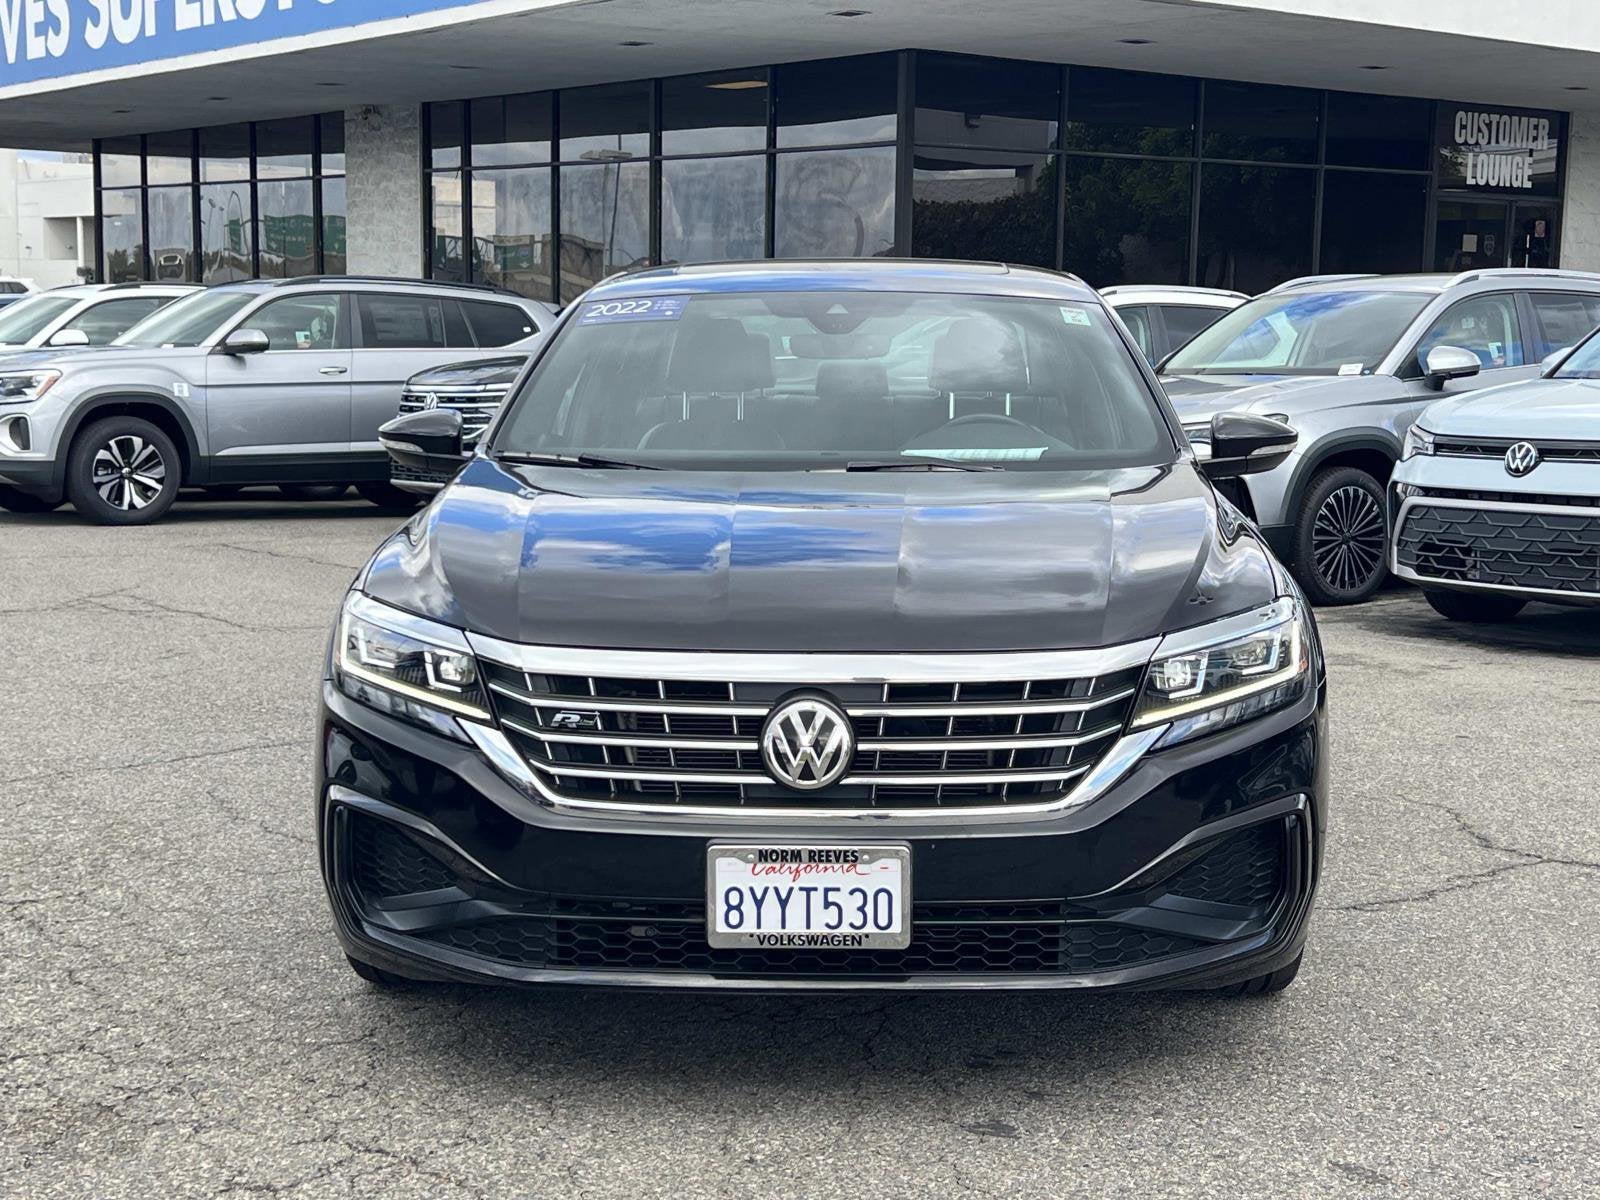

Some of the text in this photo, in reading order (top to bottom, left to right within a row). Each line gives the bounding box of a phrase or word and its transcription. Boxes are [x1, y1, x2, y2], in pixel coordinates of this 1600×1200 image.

[1454, 111, 1550, 150] CUSTOMER
[1466, 152, 1533, 189] LOUNGE
[586, 300, 652, 317] 2022
[758, 849, 859, 863] NORM REEVES
[723, 886, 894, 931] 8YYT530
[757, 933, 862, 947] VOLKSWAGEN
